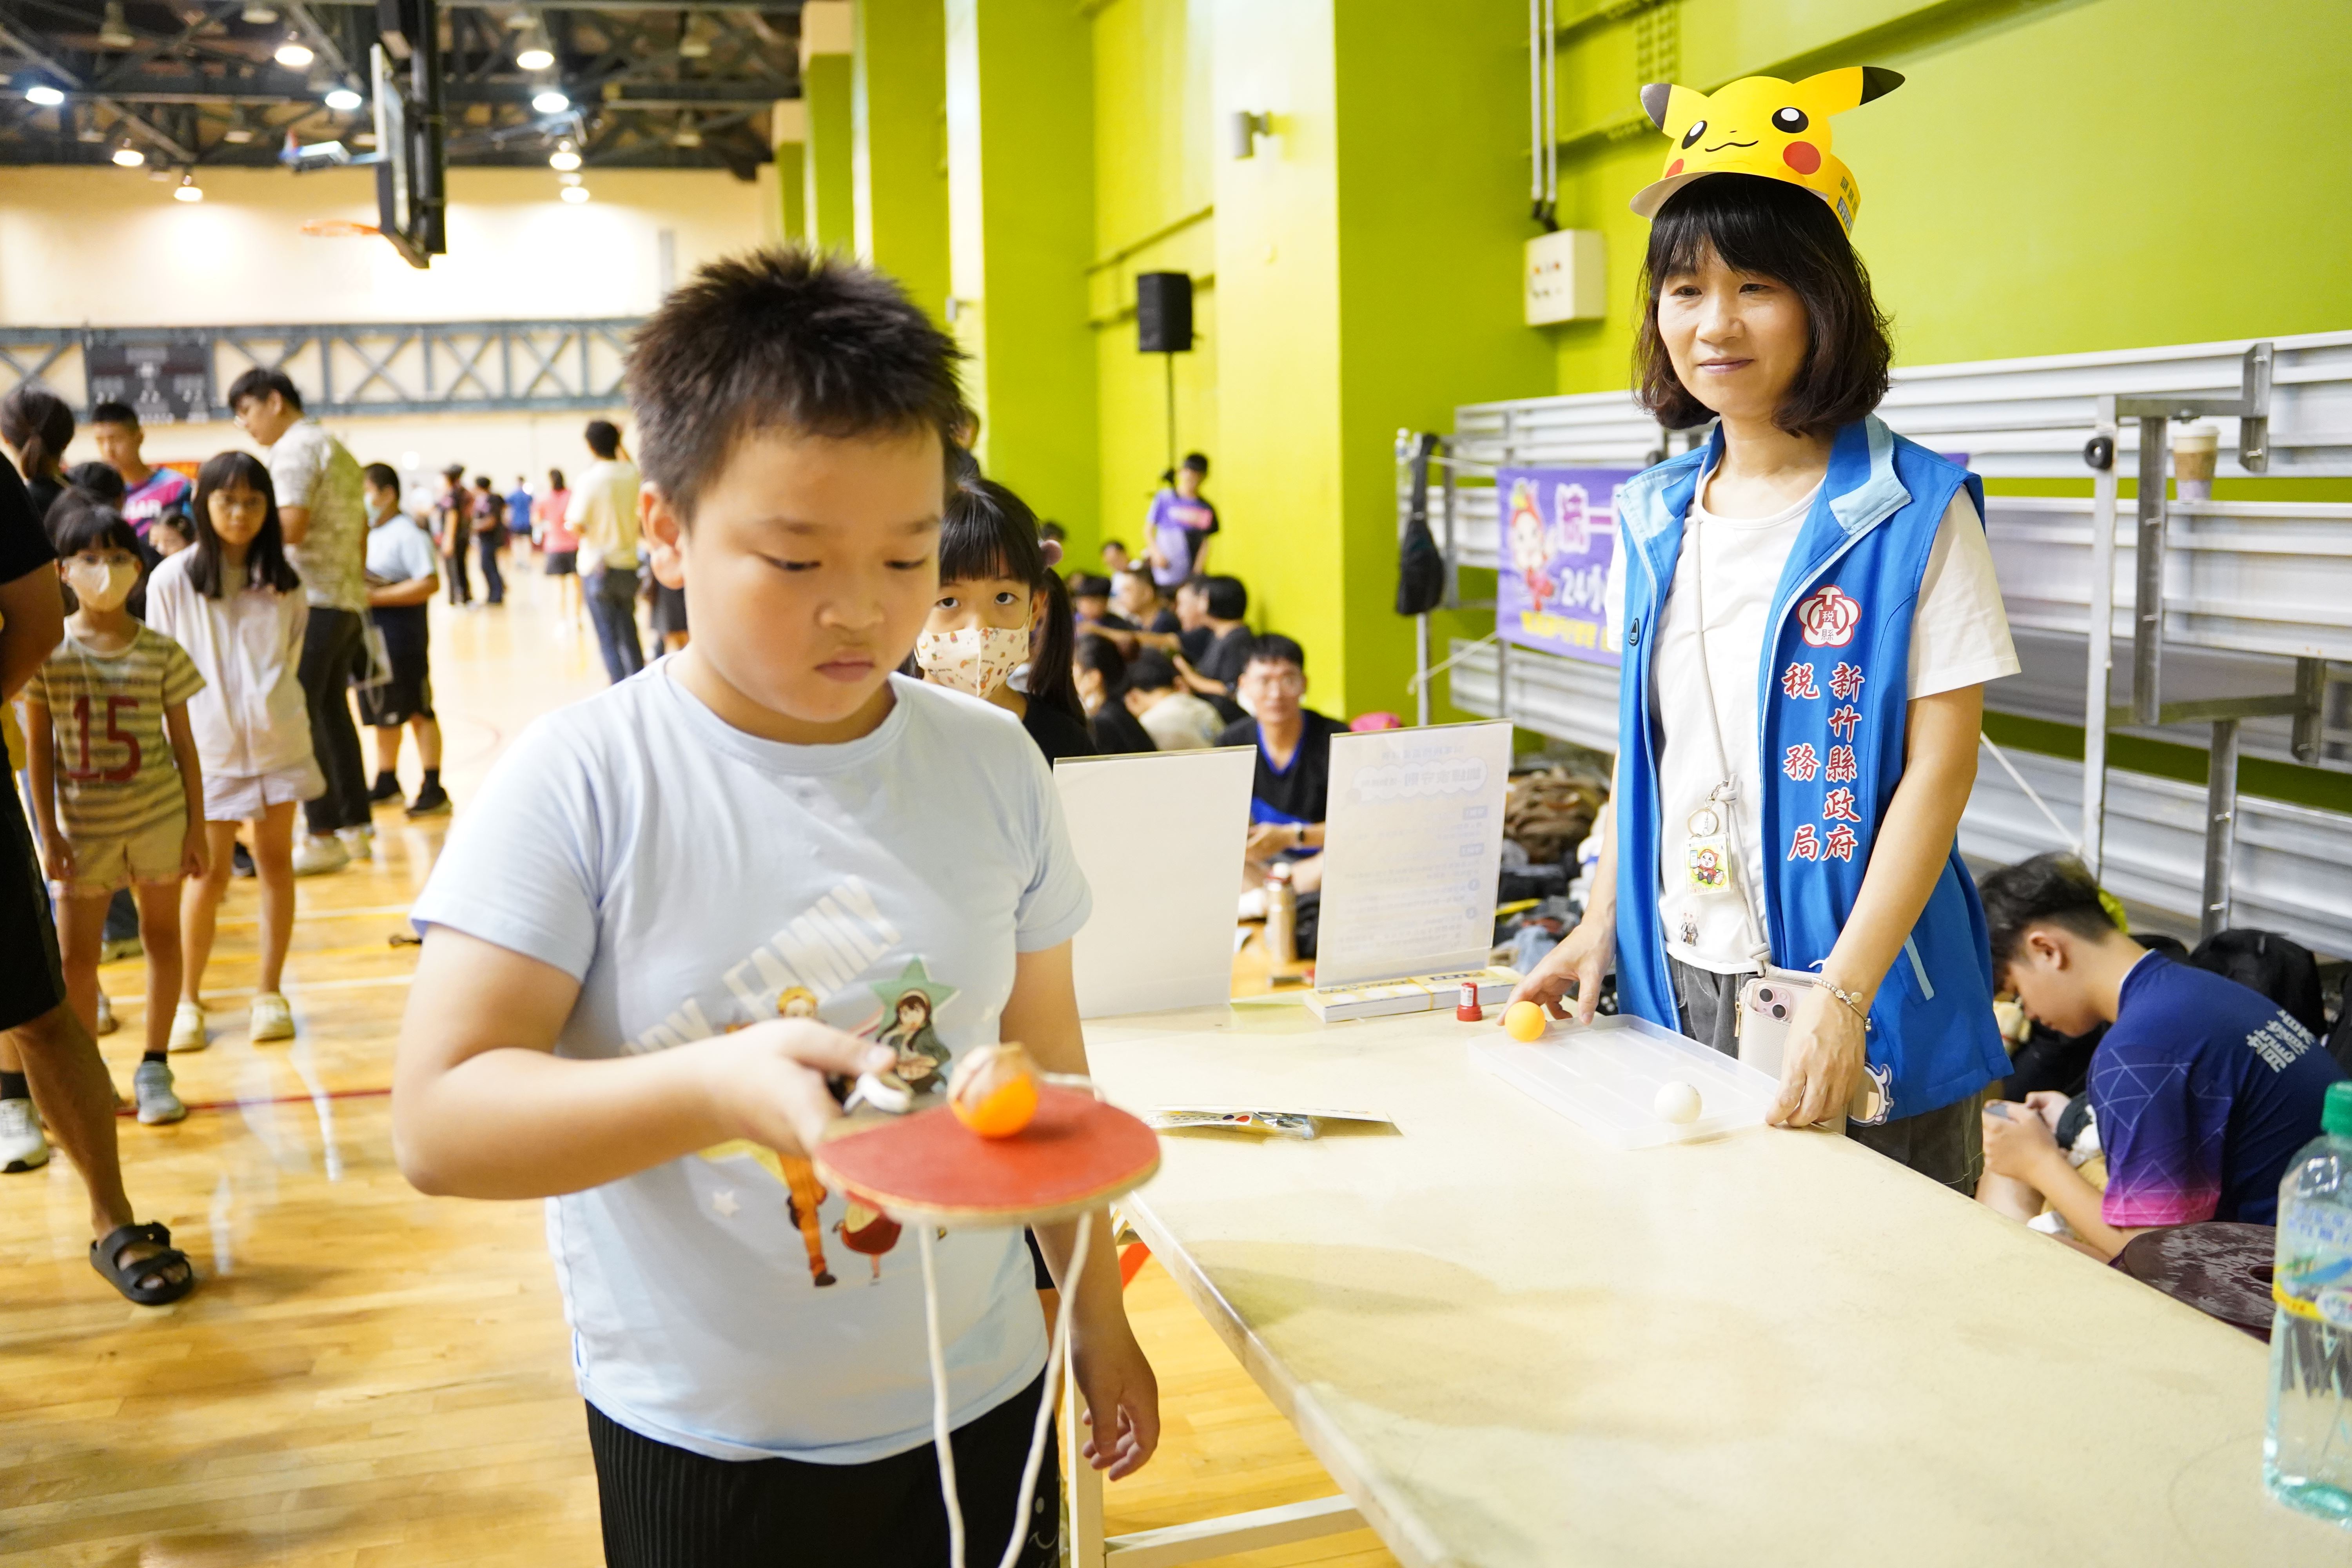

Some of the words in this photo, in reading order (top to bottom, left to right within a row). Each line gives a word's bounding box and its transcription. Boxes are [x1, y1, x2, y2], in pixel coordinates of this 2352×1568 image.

[1821, 629, 1834, 641] 縣
[67, 695, 142, 782] 15
[1822, 662, 1865, 862] 新竹縣政府
